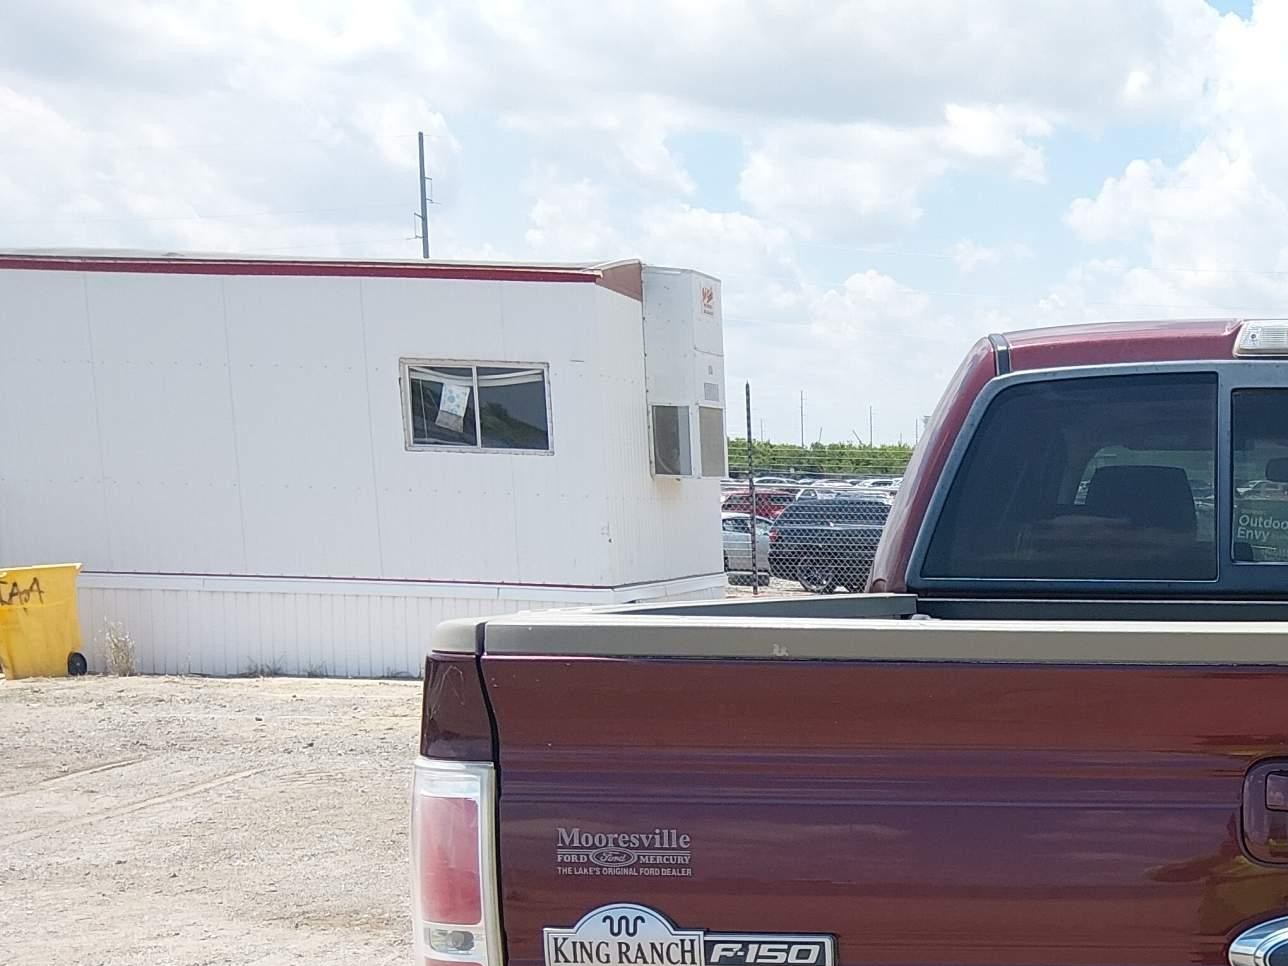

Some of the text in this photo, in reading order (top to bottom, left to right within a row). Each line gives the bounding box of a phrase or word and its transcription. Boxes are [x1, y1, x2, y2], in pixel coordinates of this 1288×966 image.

[1237, 527, 1269, 542] Envy
[557, 828, 690, 848] Mooresville
[557, 854, 588, 863] FORD
[640, 855, 690, 864] MERCURY
[557, 867, 692, 876] THE LAKE'S ORIGINAL FORD DEALER
[552, 937, 697, 965] KING RANCH
[710, 943, 820, 964] F-150
